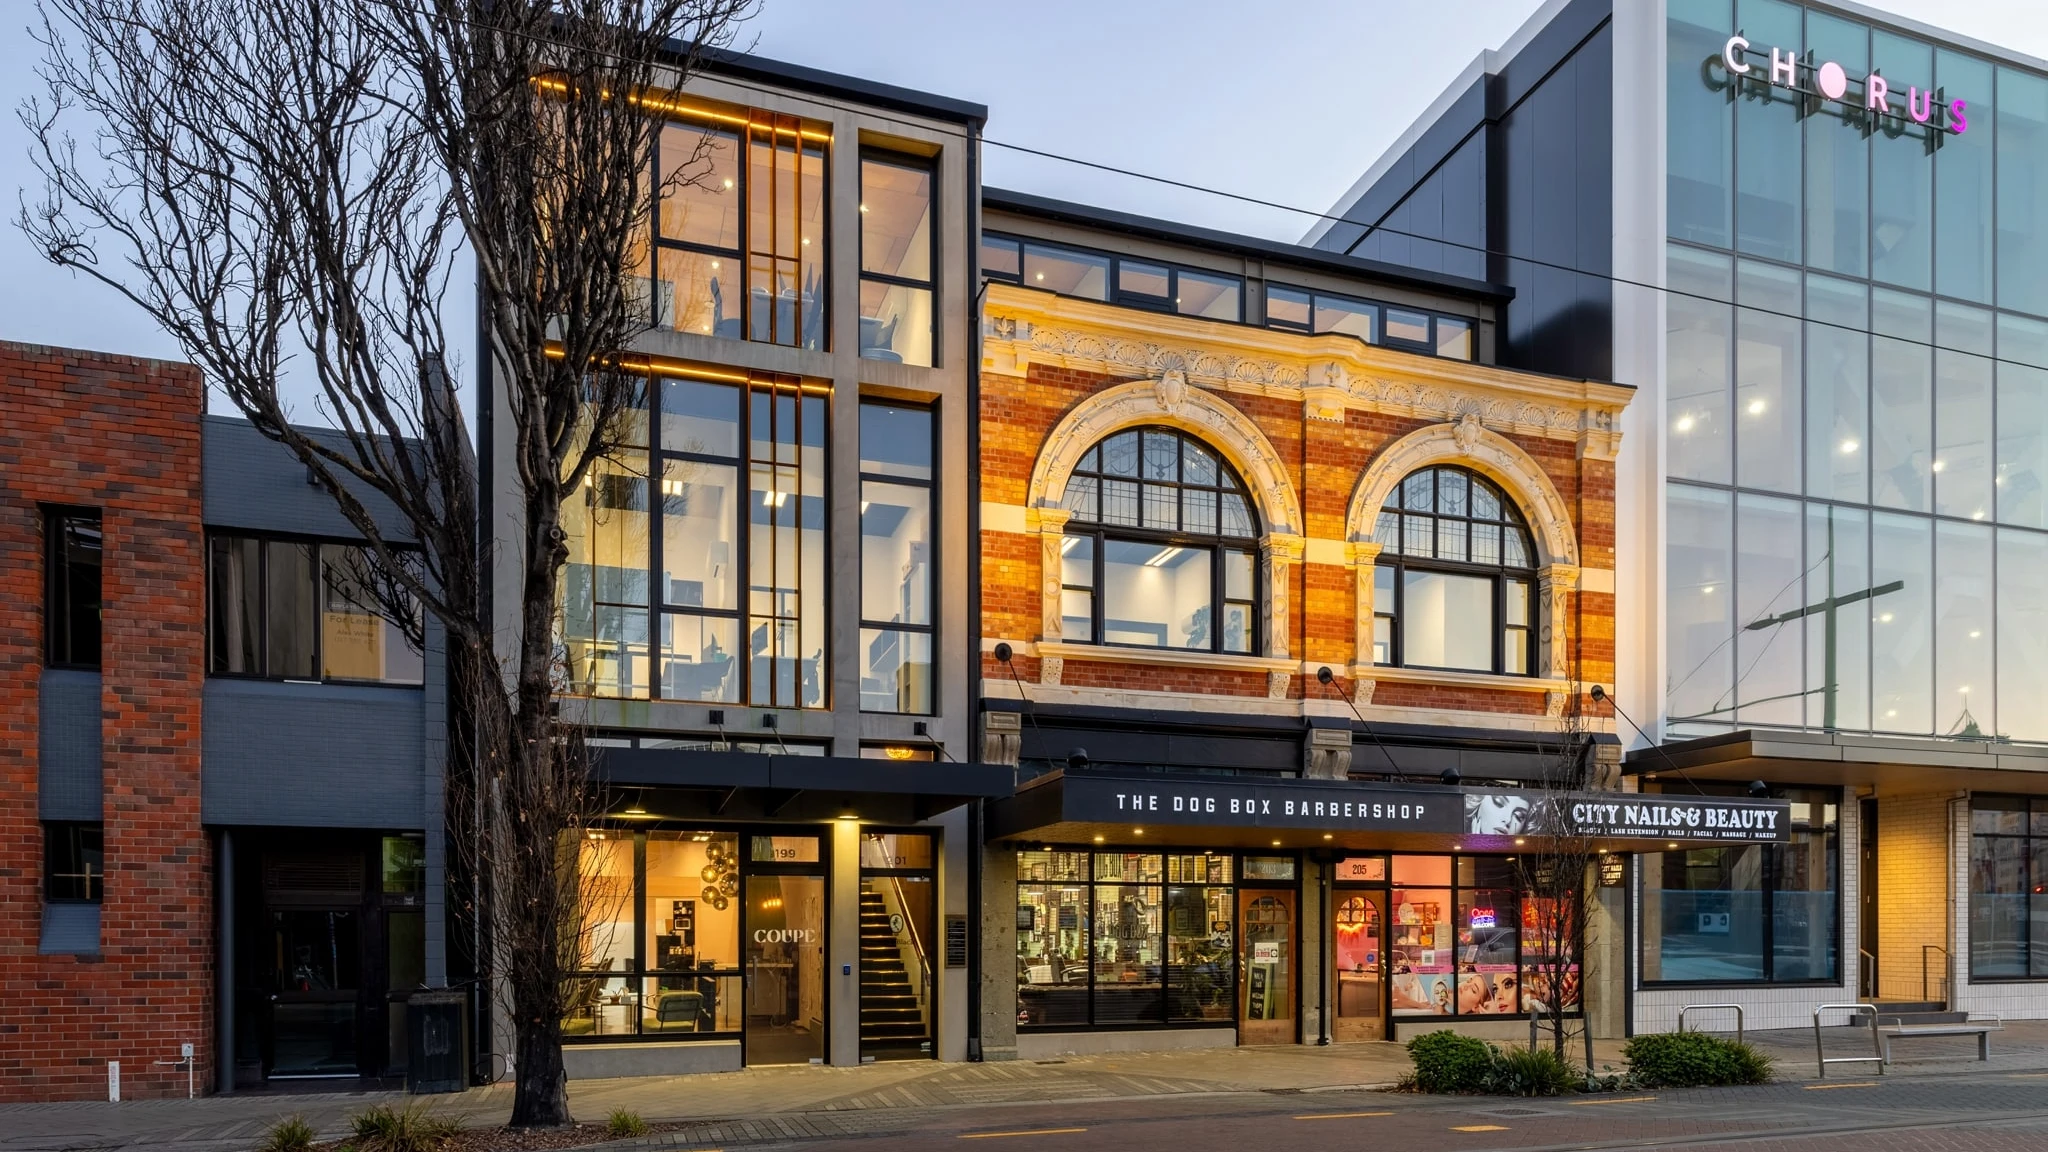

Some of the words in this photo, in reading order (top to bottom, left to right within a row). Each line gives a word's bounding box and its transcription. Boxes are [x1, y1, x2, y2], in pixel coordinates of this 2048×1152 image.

[1116, 794, 1158, 811] THE
[1173, 796, 1216, 813] DOG
[1230, 798, 1271, 814] BOX
[1285, 800, 1425, 820] BARBERSHOP
[1572, 803, 1620, 824] CITY
[1624, 805, 1683, 827] NAILS
[1705, 808, 1779, 830] BEAUTY
[1627, 828, 1659, 836] EXTENSION
[1667, 829, 1685, 837] NAILS
[775, 849, 796, 859] 199
[1352, 864, 1367, 875] 205
